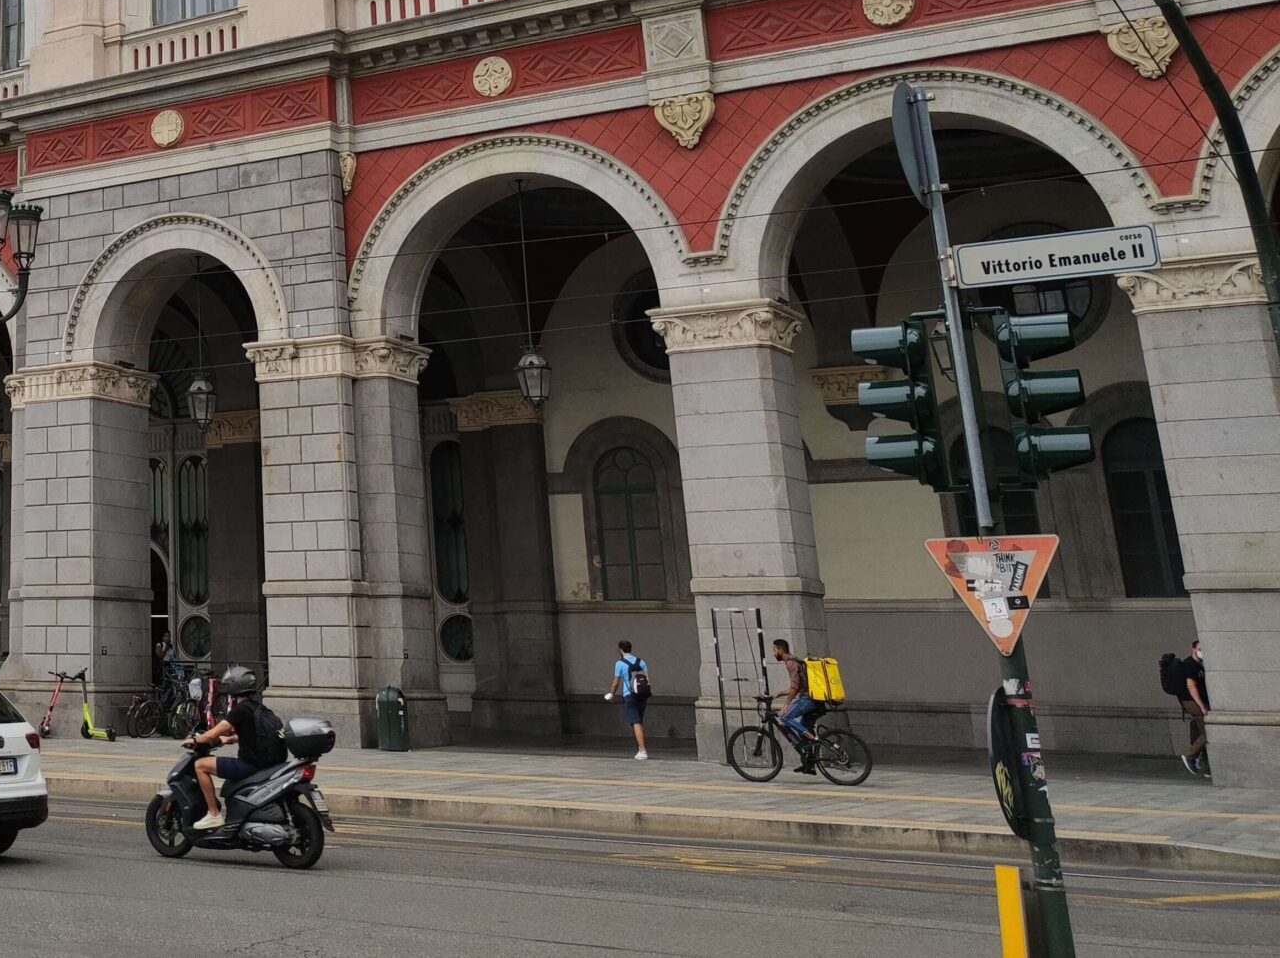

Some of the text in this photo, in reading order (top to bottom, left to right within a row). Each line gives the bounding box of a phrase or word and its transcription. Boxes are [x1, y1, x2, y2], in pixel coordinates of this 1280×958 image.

[1119, 233, 1142, 241] corso
[981, 243, 1145, 275] Vittorio Emanuele II
